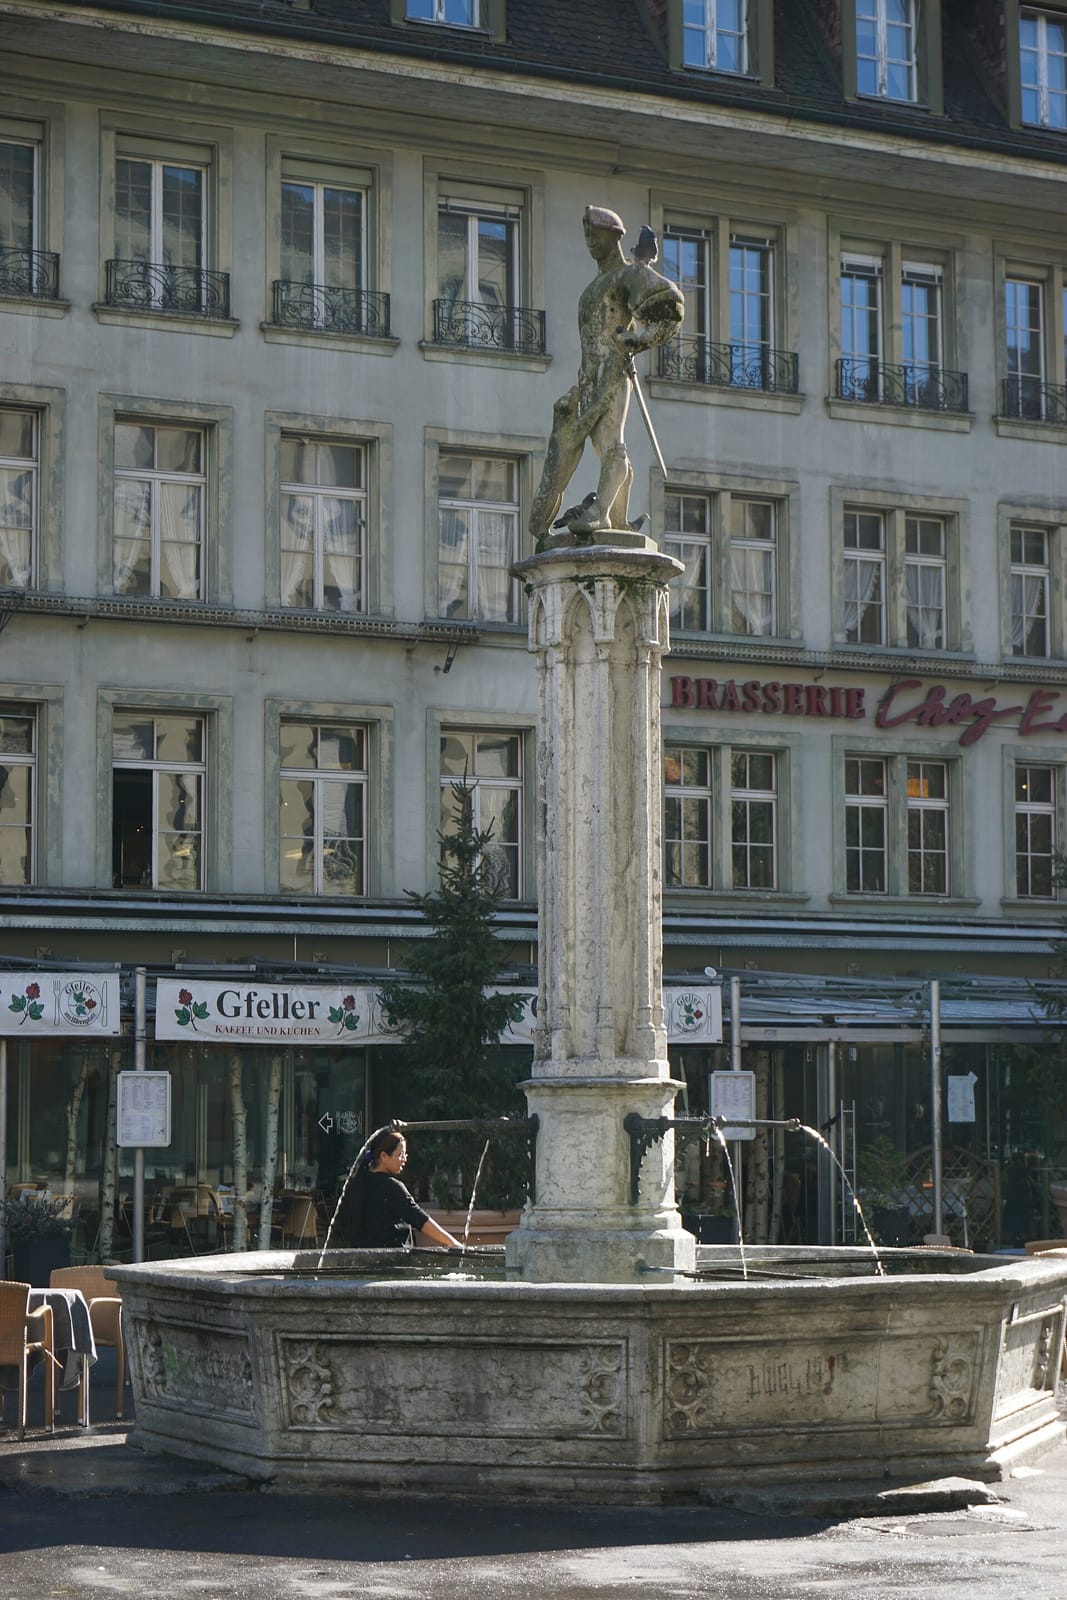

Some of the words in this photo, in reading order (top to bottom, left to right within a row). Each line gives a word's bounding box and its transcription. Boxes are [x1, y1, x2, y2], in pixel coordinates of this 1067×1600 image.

[671, 675, 866, 719] BRASSERIE
[875, 679, 1023, 746] Chez
[65, 981, 95, 995] Gfeller
[216, 990, 321, 1020] Gfeller
[215, 1024, 254, 1035] KAFFEE
[256, 1026, 278, 1036] UND
